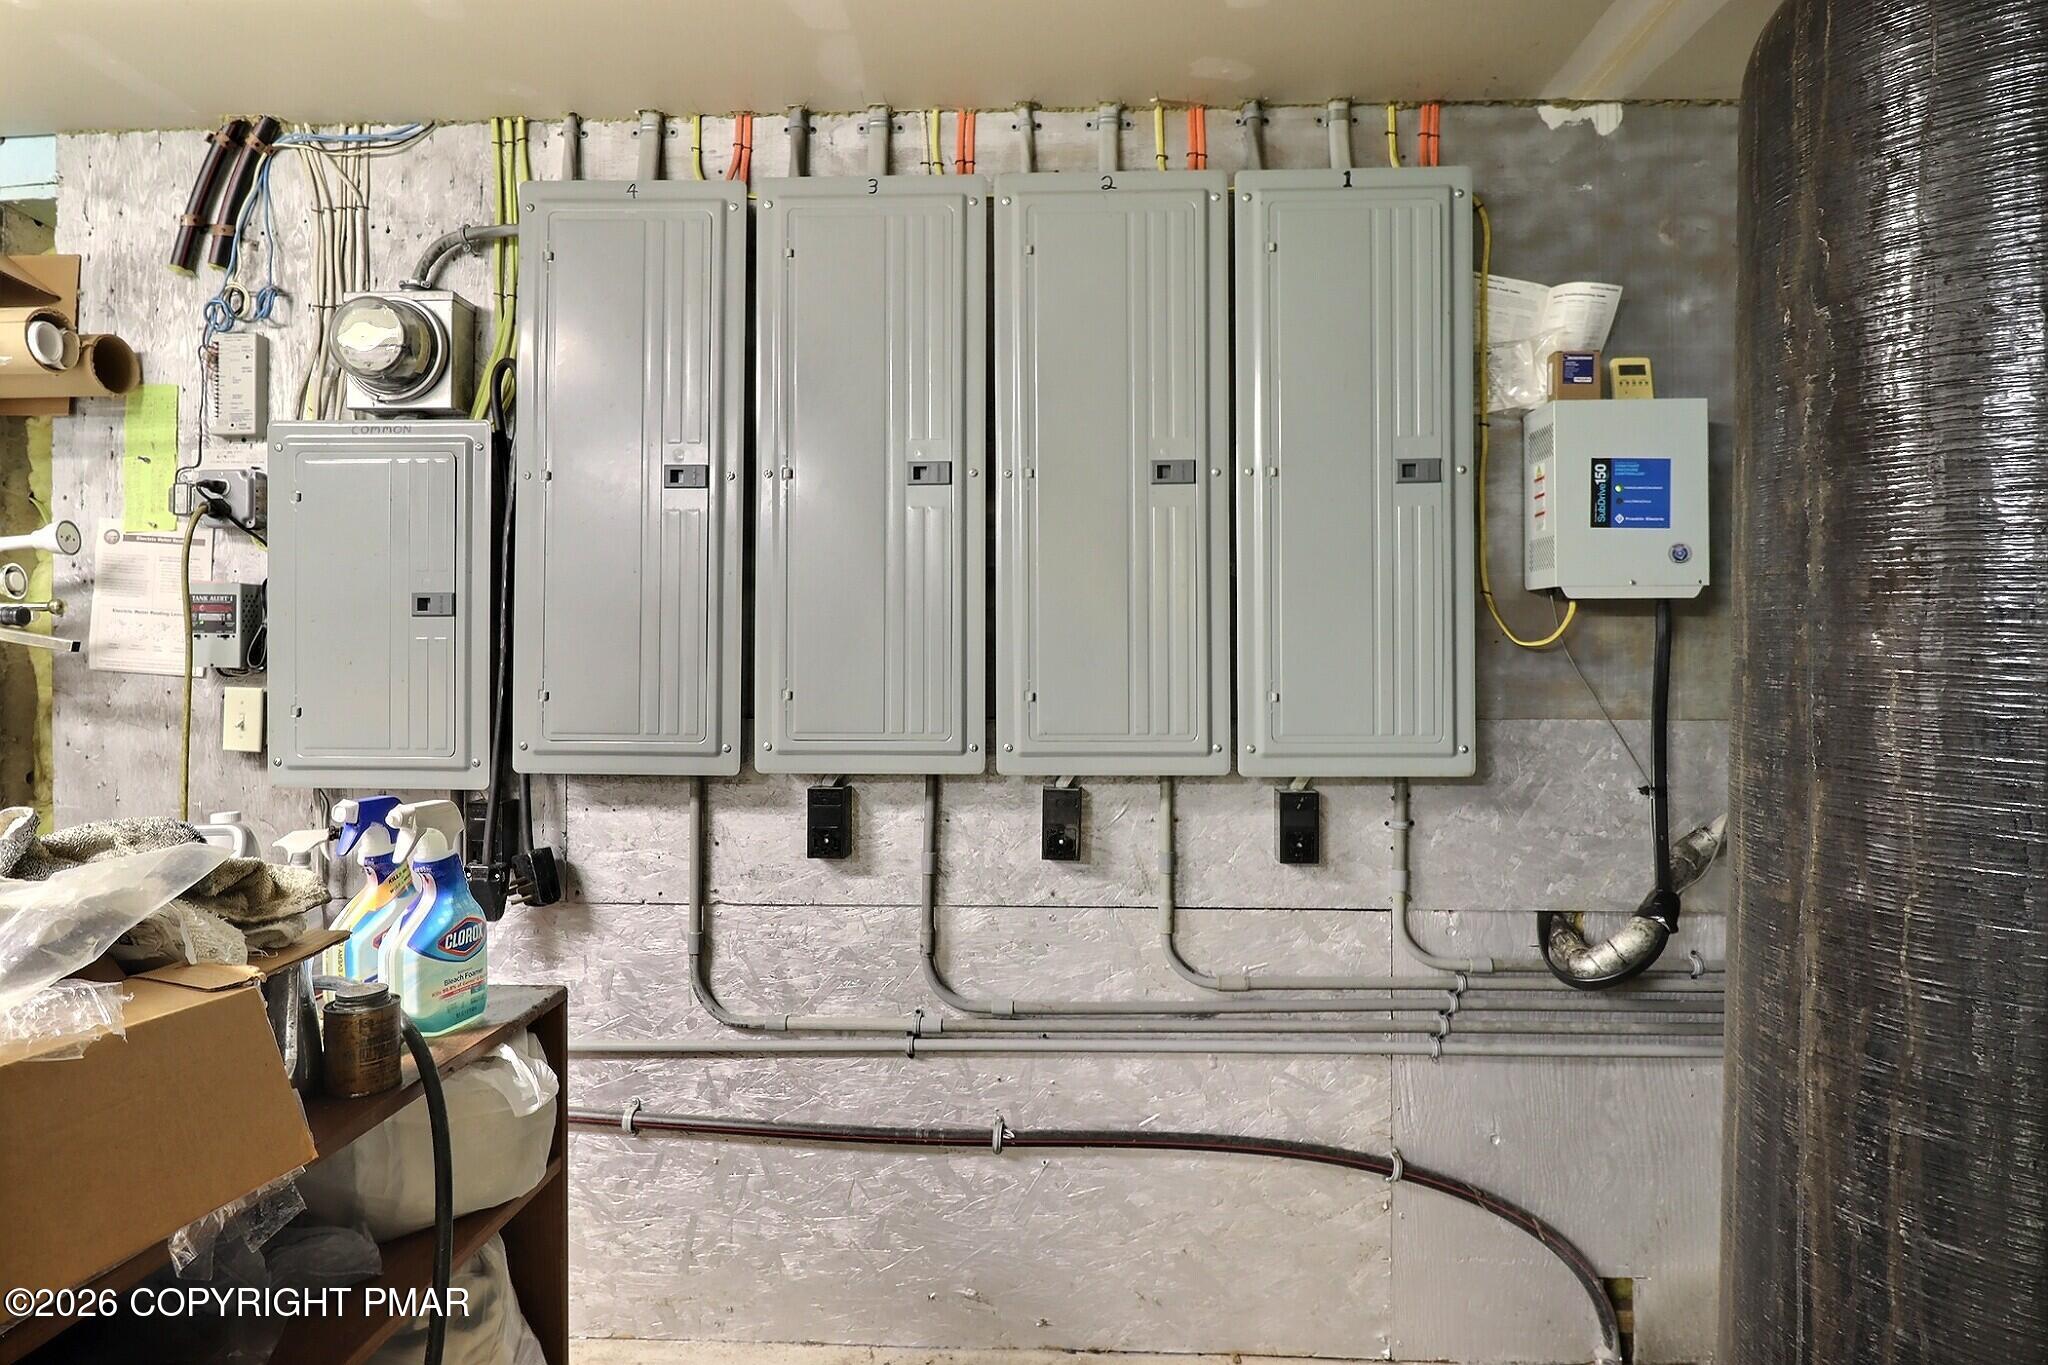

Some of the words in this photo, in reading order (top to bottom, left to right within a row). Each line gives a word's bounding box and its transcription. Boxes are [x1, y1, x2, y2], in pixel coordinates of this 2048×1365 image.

[868, 178, 878, 194] 3
[1101, 175, 1117, 190] 2
[1343, 170, 1353, 188] 1
[626, 183, 638, 199] 4
[351, 425, 412, 435] COMMON
[444, 923, 484, 950] CLOROX
[444, 974, 464, 987] Bleach
